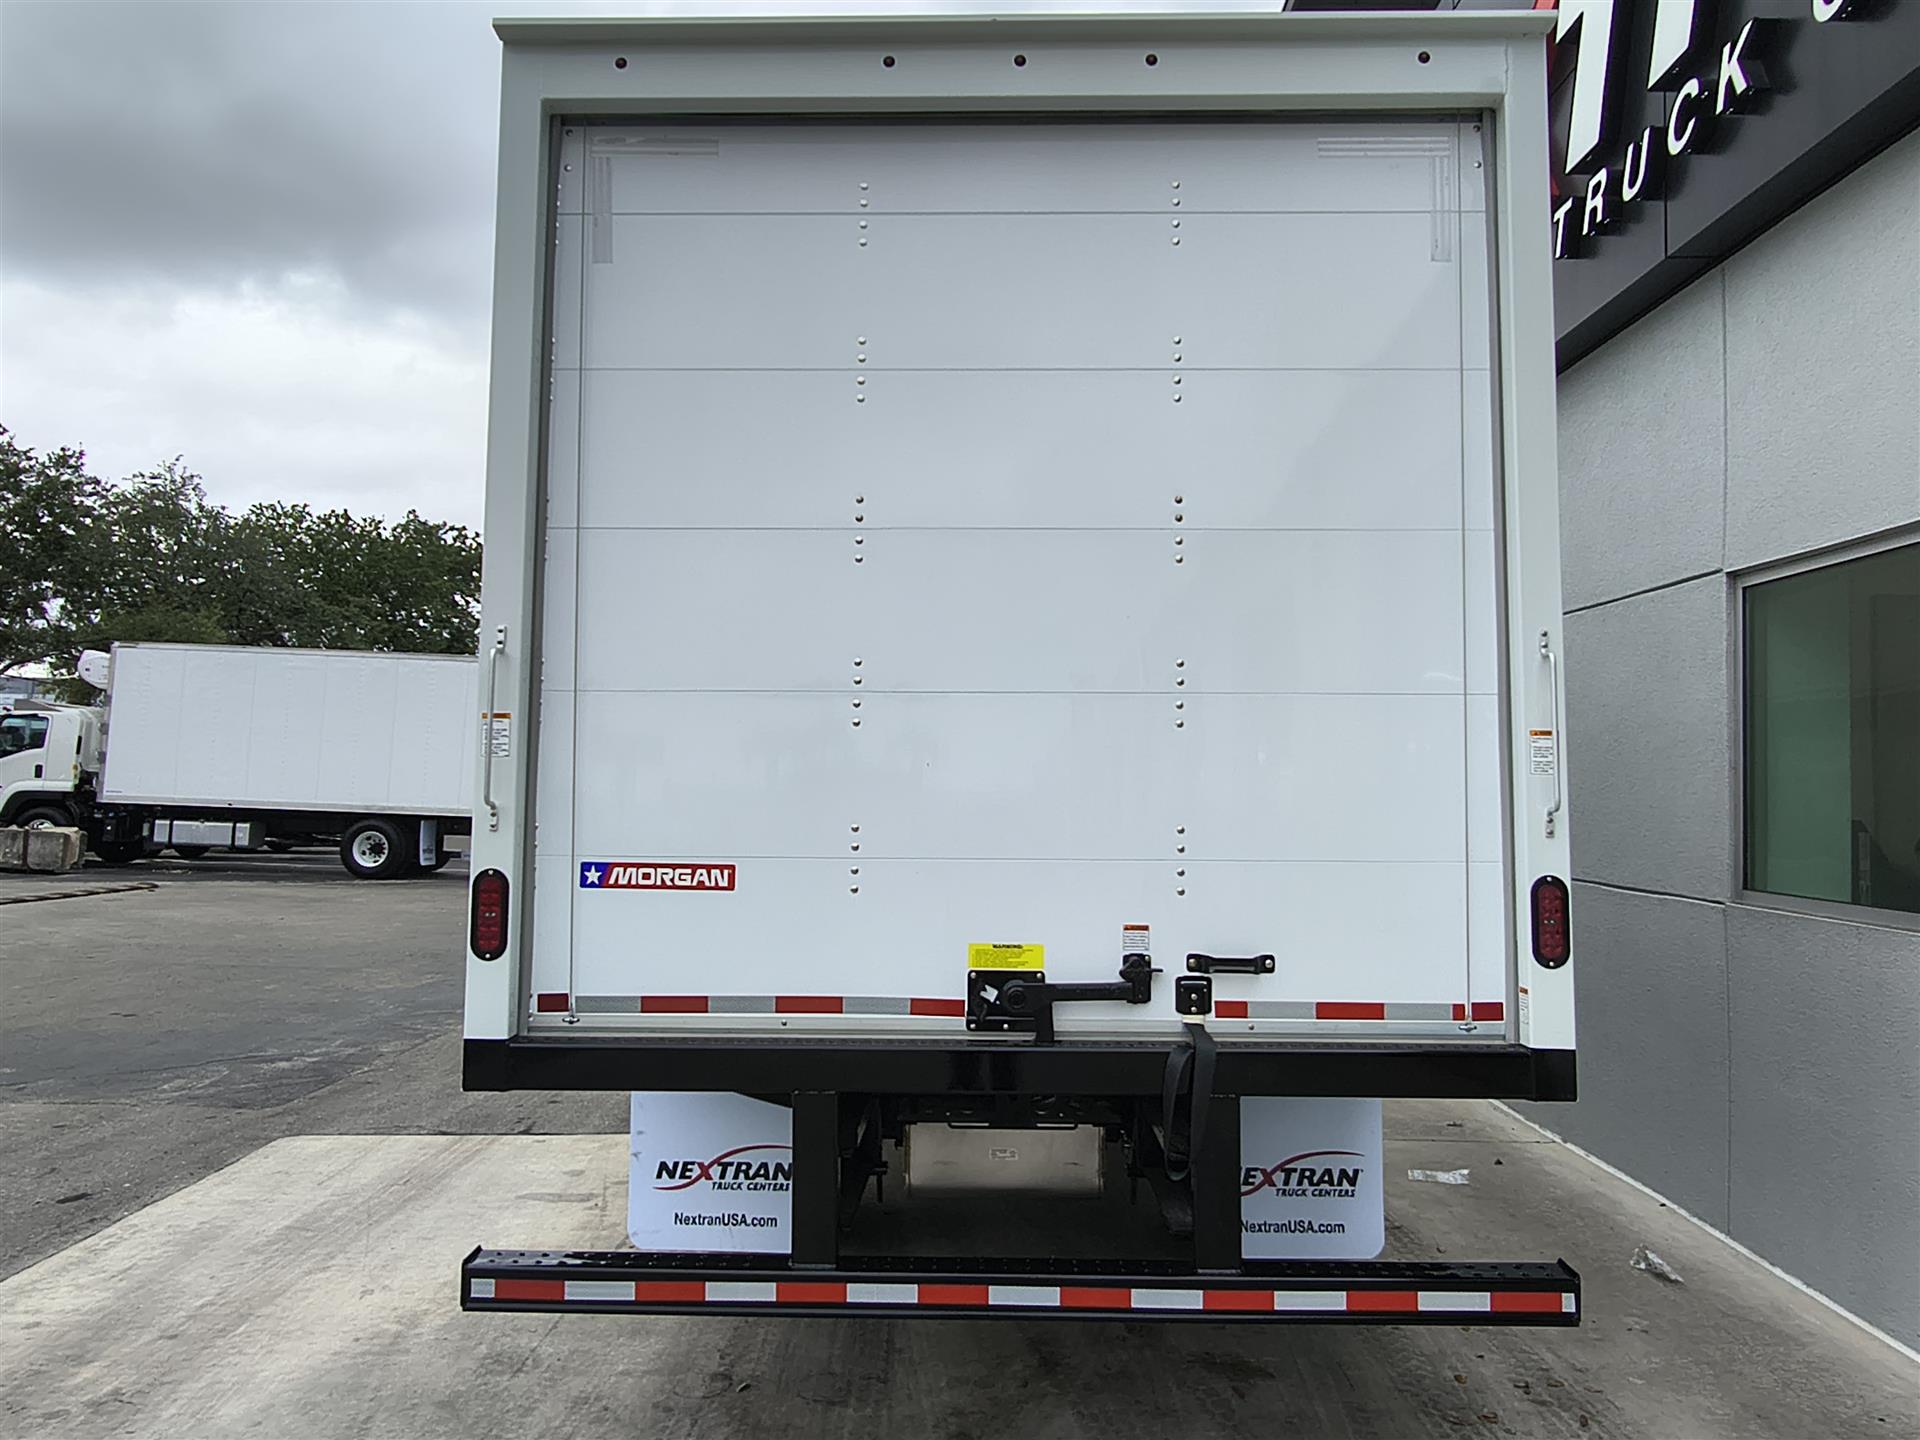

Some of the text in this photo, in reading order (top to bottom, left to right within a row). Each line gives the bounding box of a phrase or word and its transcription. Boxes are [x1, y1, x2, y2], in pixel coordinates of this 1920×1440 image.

[1553, 18, 1756, 259] TRUCK
[608, 866, 730, 888] MORGAN
[655, 1160, 793, 1182] NEXTRAN
[1240, 1166, 1360, 1188] EXTRAN
[711, 1181, 790, 1192] TRUCK CENTERS
[1275, 1187, 1356, 1198] TRUCK CENTERS
[673, 1212, 778, 1228] NextranUSA.com
